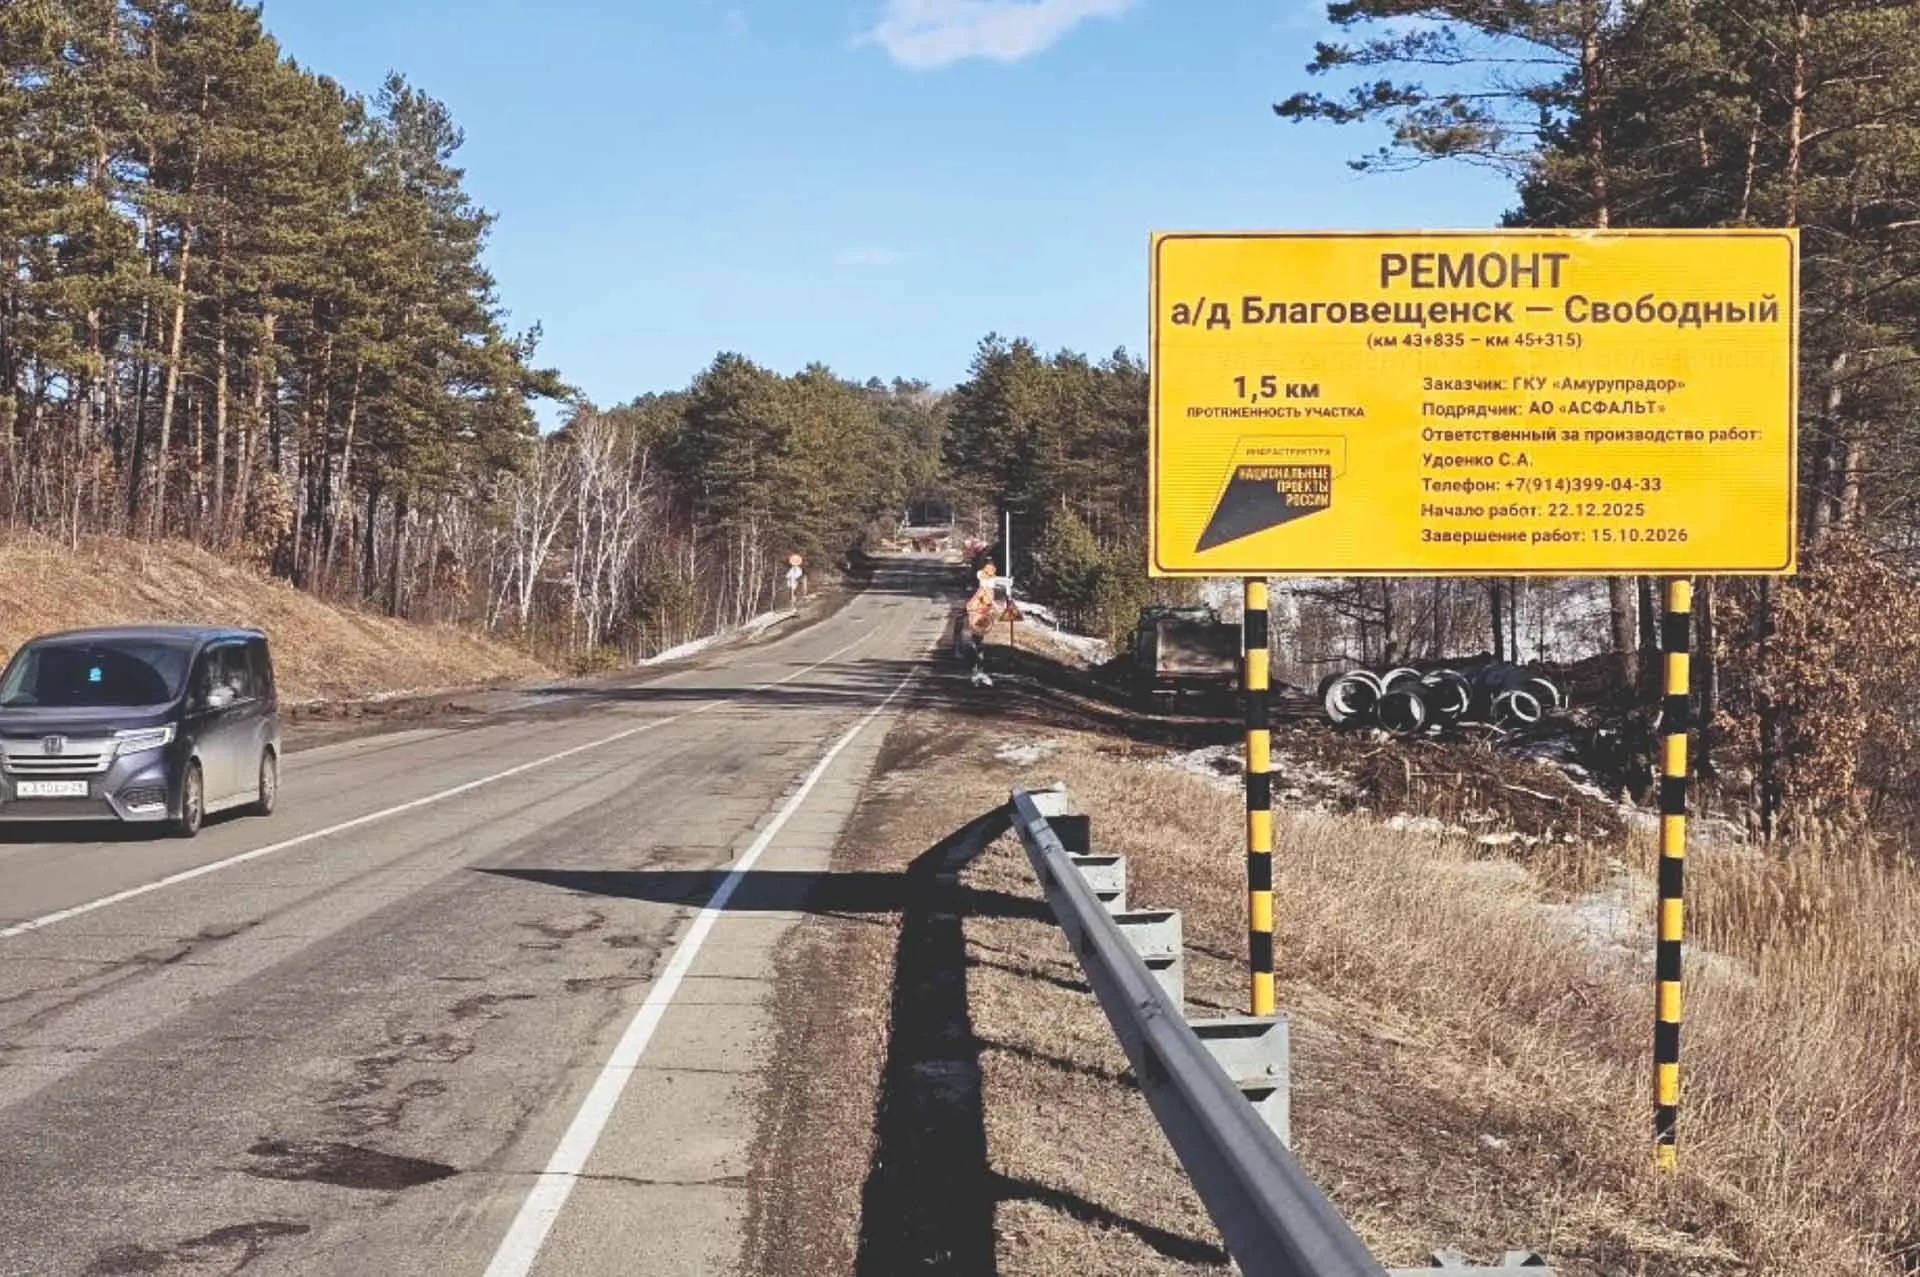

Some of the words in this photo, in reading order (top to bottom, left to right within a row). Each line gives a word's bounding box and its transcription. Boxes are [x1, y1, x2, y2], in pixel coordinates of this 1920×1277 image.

[1381, 252, 1570, 289] РЕМОНТ
[1171, 296, 1231, 330] а/д
[1242, 296, 1514, 329] Благовещенск
[1565, 293, 1779, 329] Свободный
[1367, 333, 1397, 350] (км
[1402, 332, 1464, 347] 43+835
[1486, 335, 1509, 347] км
[1514, 332, 1582, 350] 45+315)
[1233, 376, 1277, 403] 1,5
[1286, 382, 1320, 398] км
[1423, 376, 1507, 392] Заказчик:
[1513, 376, 1547, 391] ГКУ
[1553, 376, 1685, 395] «Амурупрадор»
[1187, 406, 1301, 419] ПРОТЯЖЕННОСТЬ
[1305, 406, 1364, 418] УЧАСТКА
[1422, 401, 1522, 420] Подрядчик:
[1528, 401, 1554, 416] АО
[1559, 400, 1666, 416] «АСФАЛЬТ»
[1422, 426, 1556, 443] Ответственный
[1561, 430, 1579, 442] за
[1584, 430, 1704, 445] производство
[1709, 426, 1762, 445] работ:
[1422, 452, 1494, 470] Удоенко
[1498, 452, 1534, 467] С.А.
[1239, 468, 1329, 481] НАЦИОНАЛЬНЫЕ
[1277, 481, 1329, 493] ПРОЕКТЫ
[1421, 477, 1500, 495] Телефон:
[1505, 477, 1662, 495] +7(914)399-04-33
[1286, 494, 1329, 507] РОССИИ
[1421, 503, 1484, 518] Начало
[1488, 503, 1541, 520] работ:
[1548, 503, 1645, 518] 22.12.2025
[1422, 529, 1527, 546] Завершение
[1532, 528, 1585, 546] работ:
[1592, 528, 1688, 543] 15.10.2026
